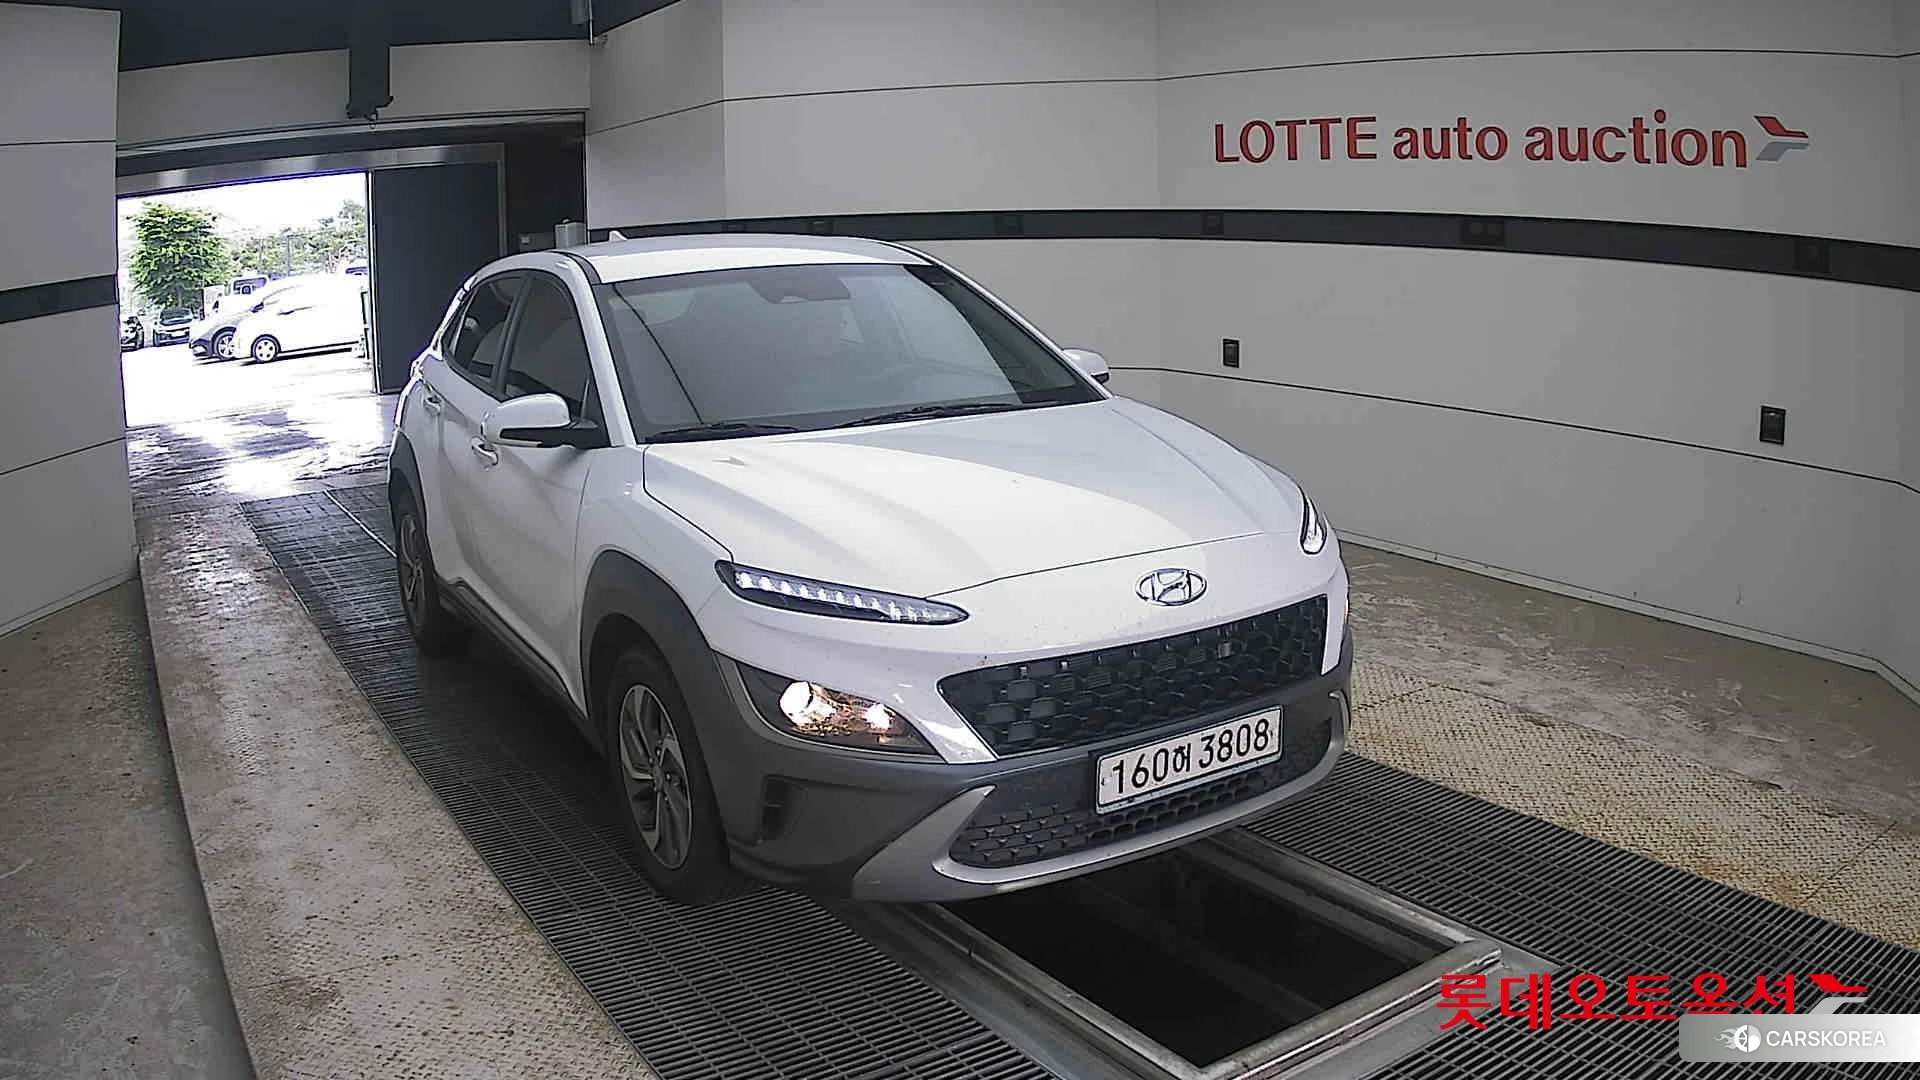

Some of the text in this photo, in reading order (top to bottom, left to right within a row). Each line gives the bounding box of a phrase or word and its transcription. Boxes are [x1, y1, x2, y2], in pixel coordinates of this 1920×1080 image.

[1214, 109, 1748, 168] LOTTE auto auction
[1198, 718, 1270, 769] 3808
